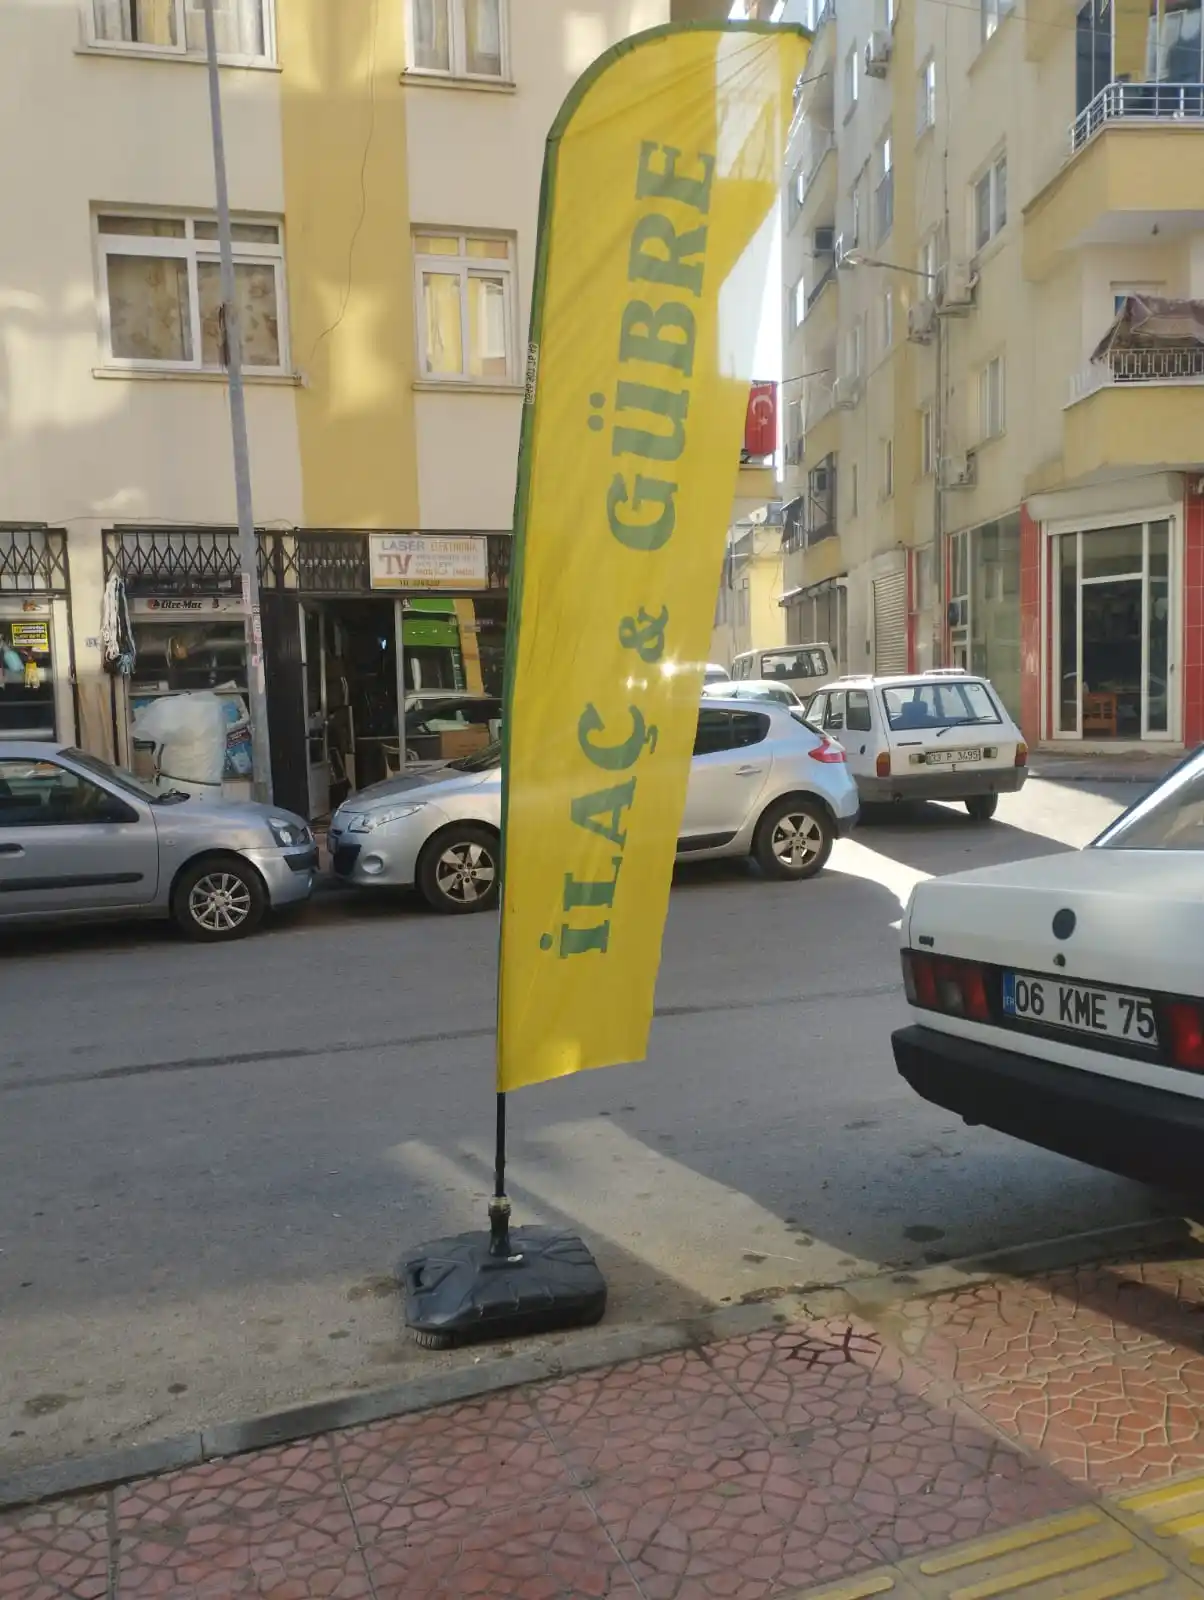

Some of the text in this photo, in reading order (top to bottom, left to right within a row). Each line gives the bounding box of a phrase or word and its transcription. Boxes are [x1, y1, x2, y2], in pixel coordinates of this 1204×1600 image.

[381, 540, 425, 551] LASER
[539, 140, 715, 960] İLAÇ & GÜBRE
[378, 553, 412, 575] TV
[946, 752, 953, 761] P
[1016, 980, 1155, 1039] 06 KME 75
